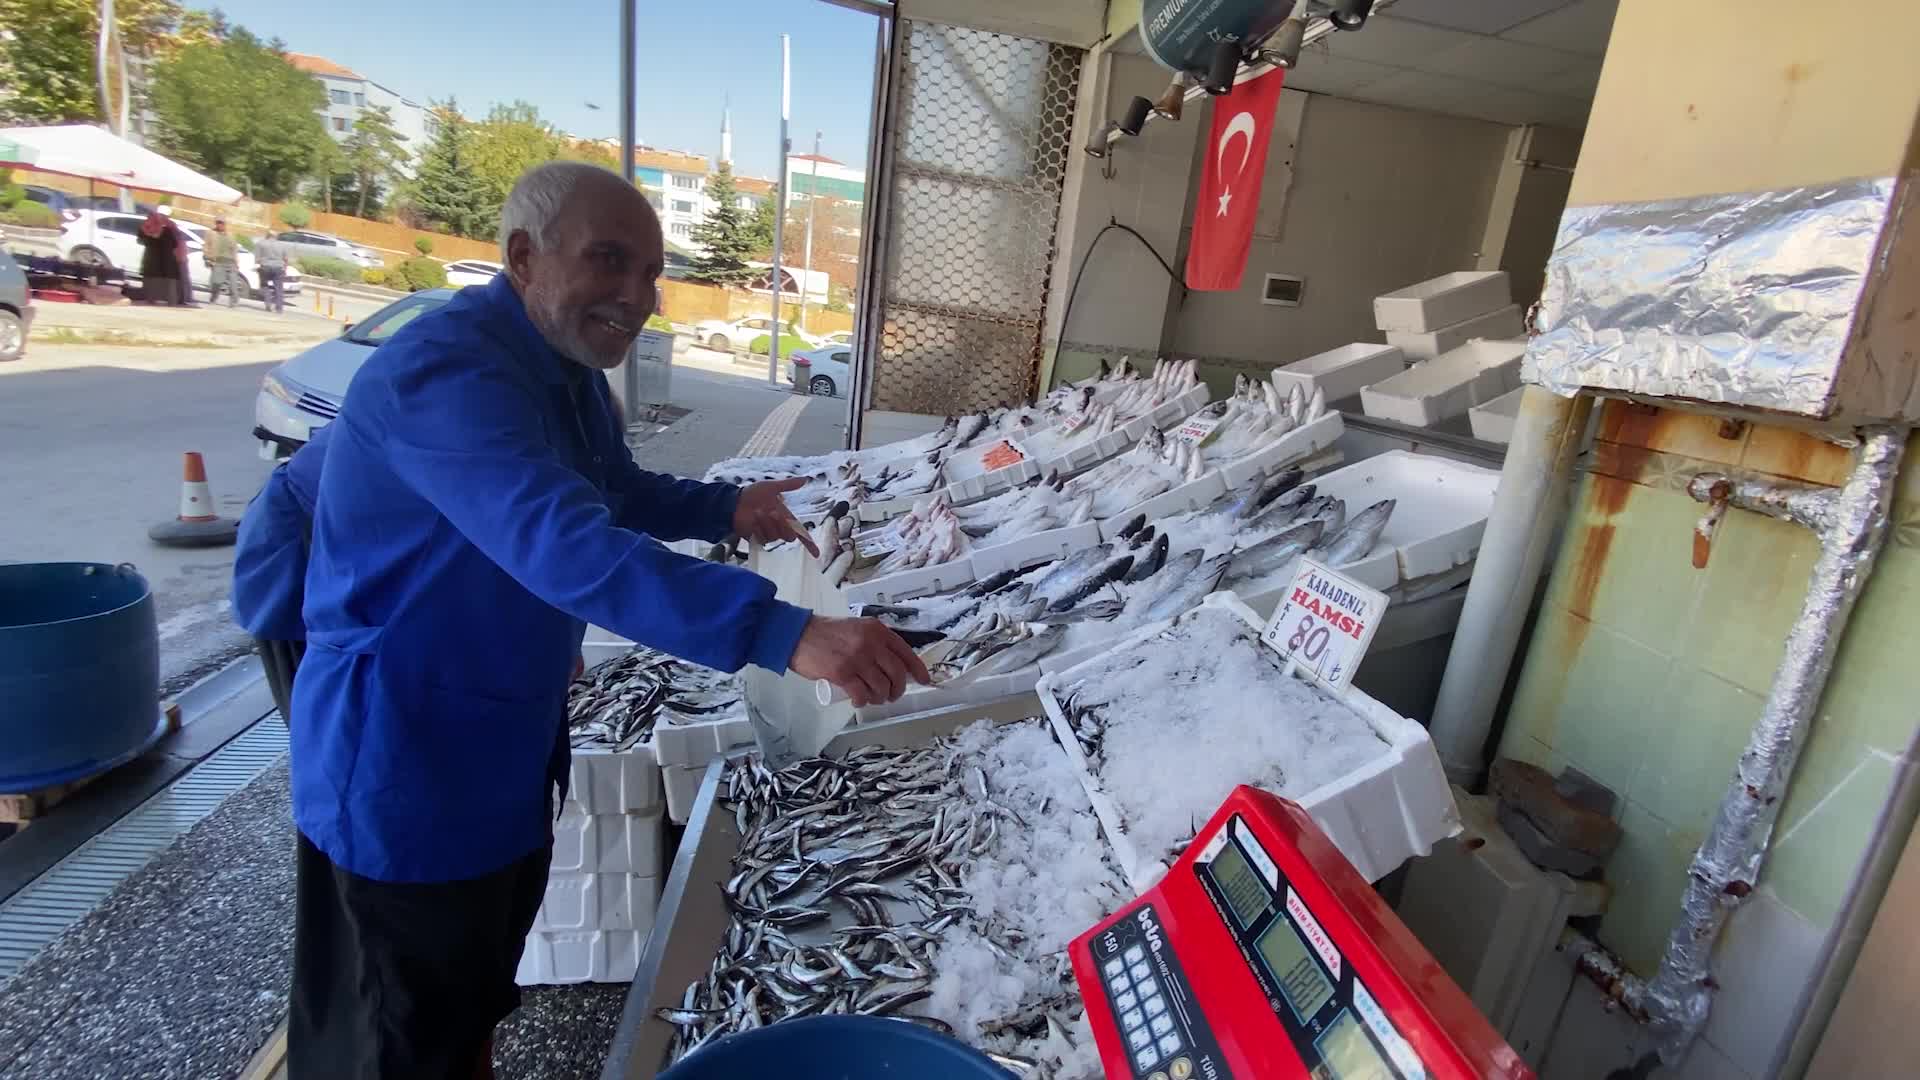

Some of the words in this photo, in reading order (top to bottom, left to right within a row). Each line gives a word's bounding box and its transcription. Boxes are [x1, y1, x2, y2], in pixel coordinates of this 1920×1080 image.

[1291, 587, 1365, 640] HAMSİ
[1103, 931, 1119, 954] 150
[1200, 1054, 1219, 1080] TÜR
